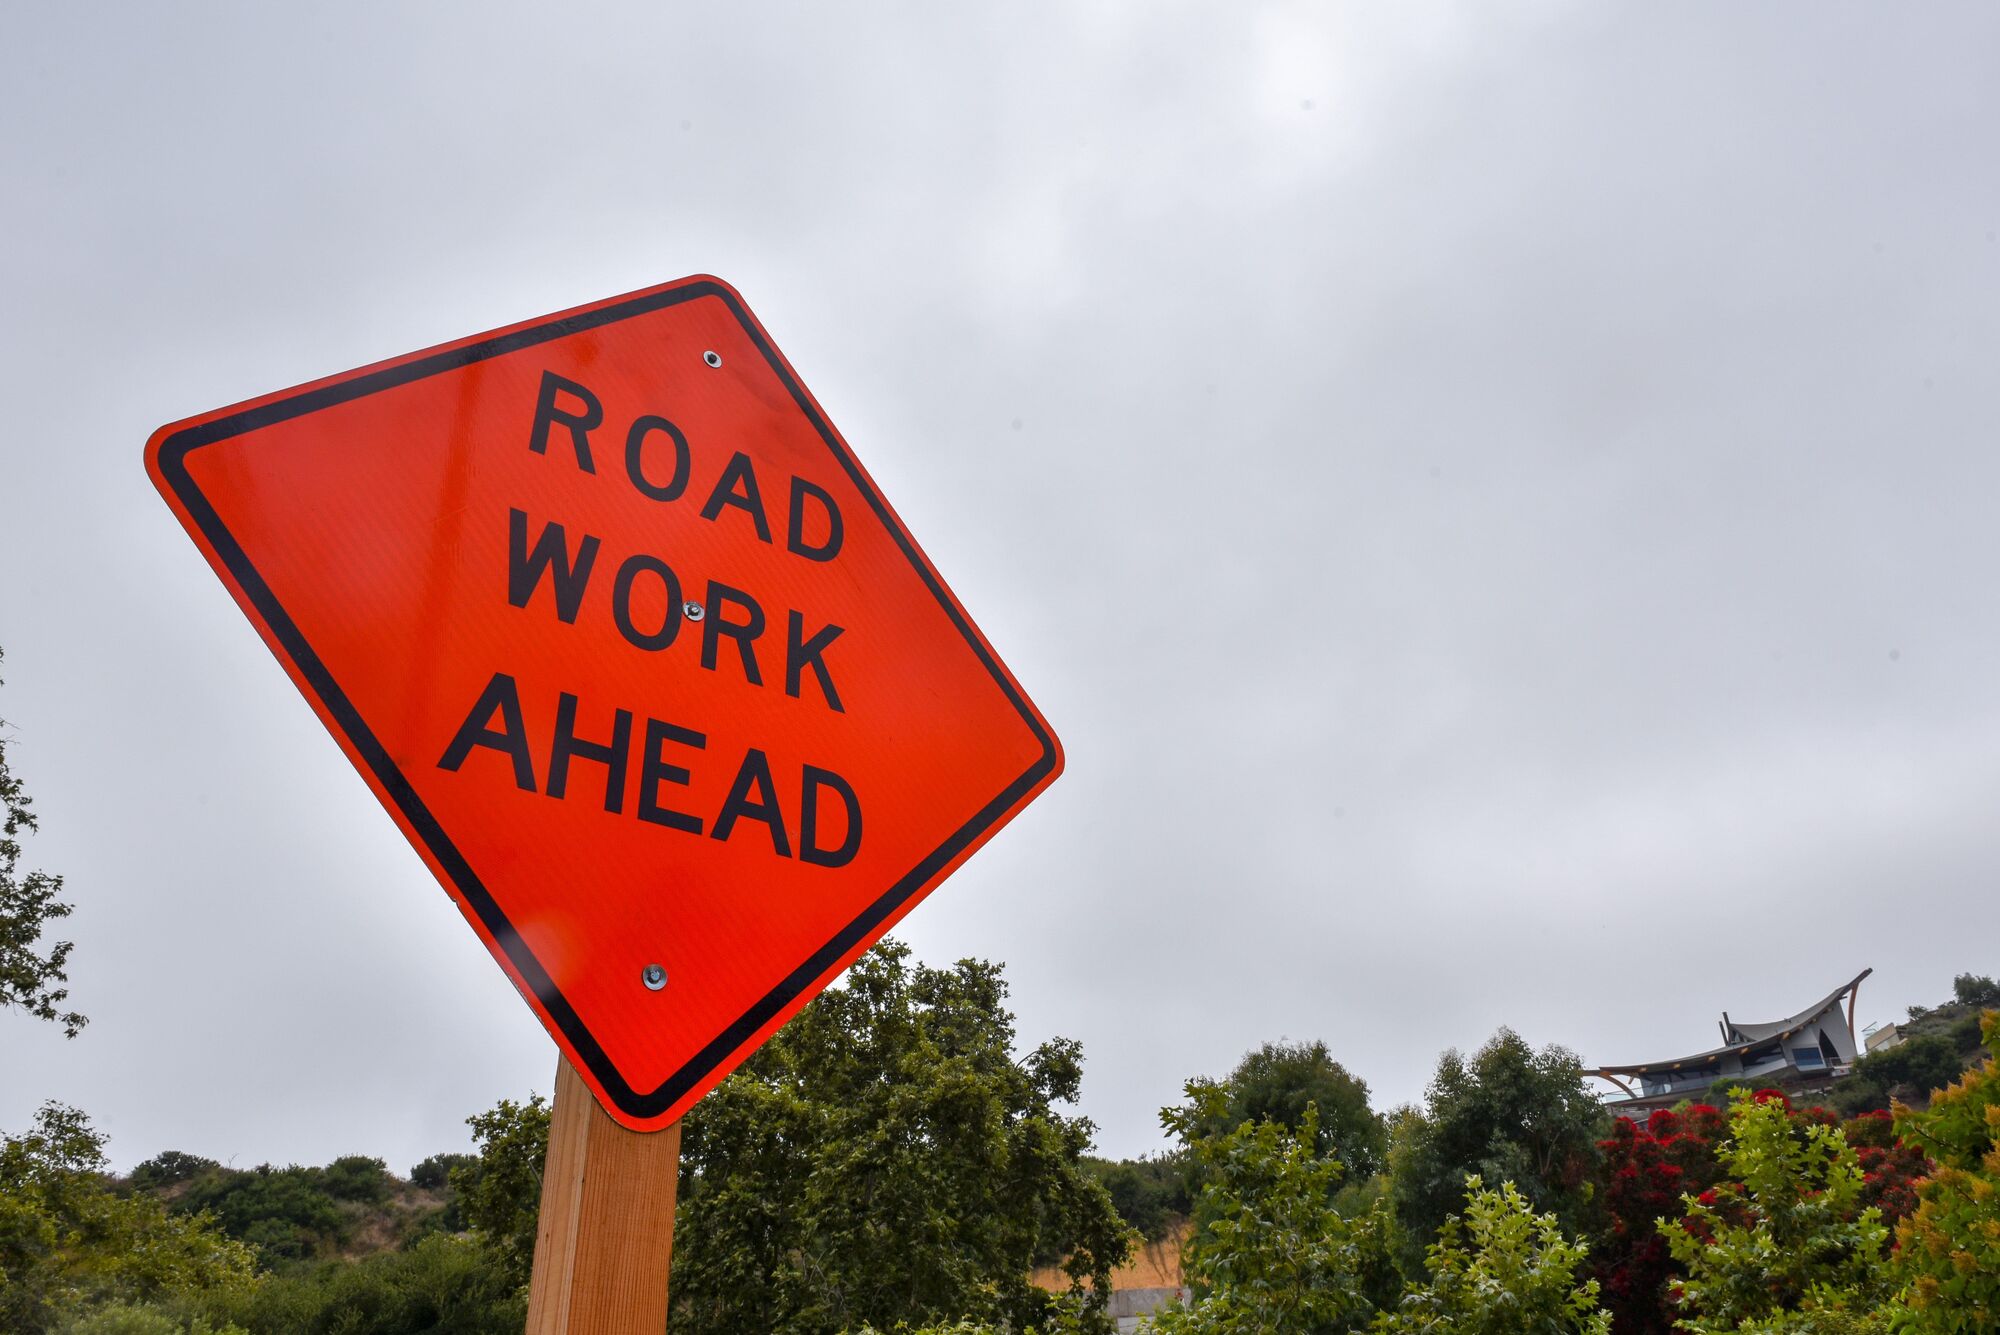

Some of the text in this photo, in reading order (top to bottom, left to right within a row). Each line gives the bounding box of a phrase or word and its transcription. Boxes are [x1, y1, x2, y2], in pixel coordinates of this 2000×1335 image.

[530, 370, 844, 562] ROAD
[508, 508, 845, 714] WORK
[437, 672, 863, 868] AHEAD
